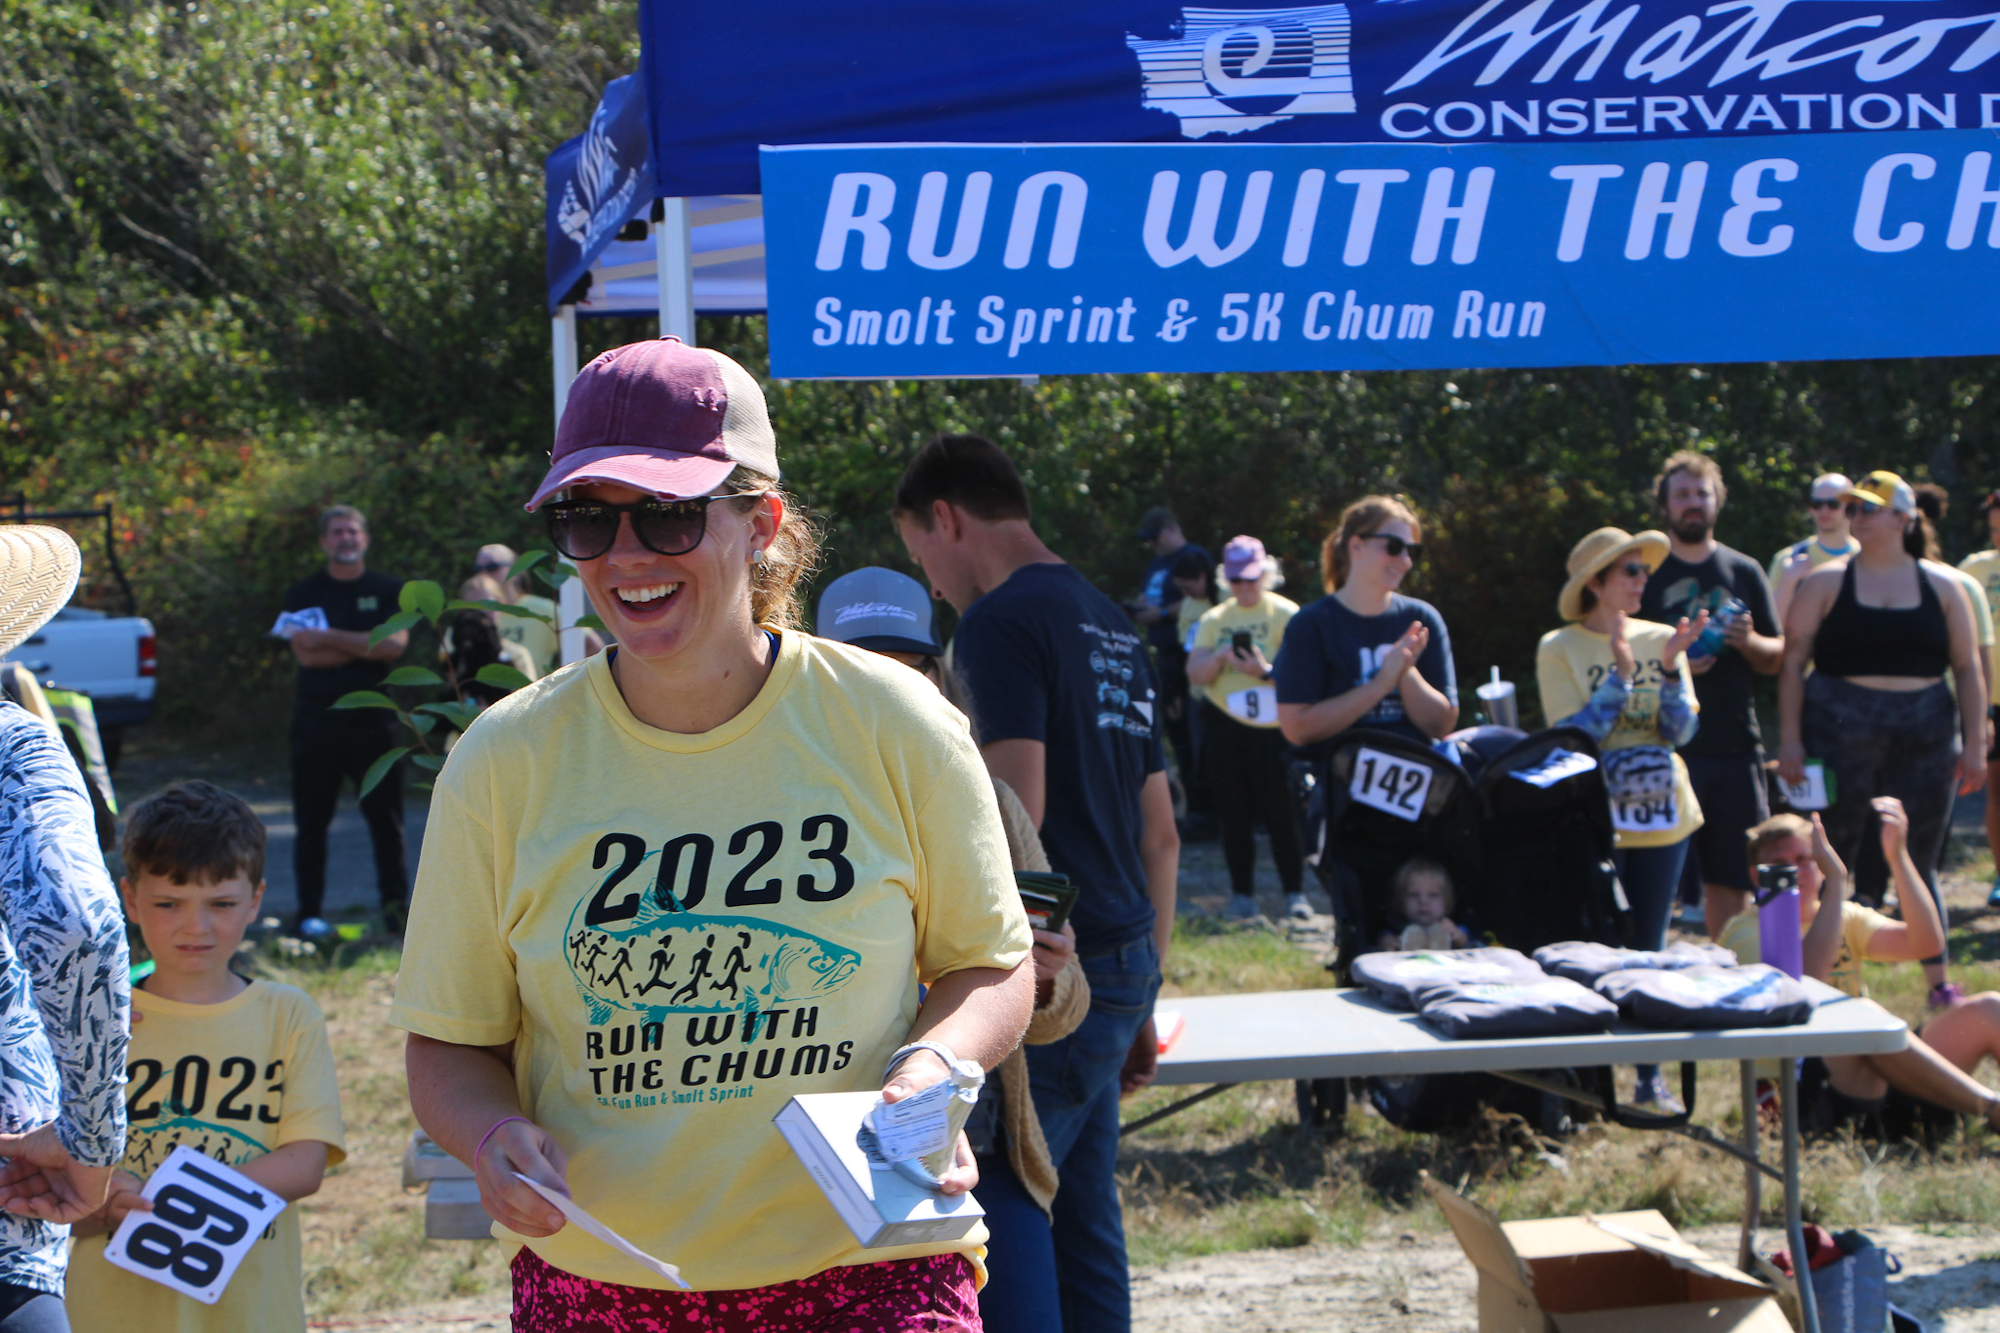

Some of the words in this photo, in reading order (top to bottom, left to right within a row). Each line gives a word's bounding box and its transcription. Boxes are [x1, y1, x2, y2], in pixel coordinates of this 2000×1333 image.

[1380, 93, 1956, 139] CONSERVATION
[815, 171, 1089, 271] RUN
[1142, 166, 1496, 269] WITH
[1550, 158, 1800, 262] THE
[812, 297, 955, 346] Smolt
[975, 295, 1137, 358] Sprint
[1156, 298, 1198, 343] &
[1216, 292, 1284, 342] 5K
[1303, 291, 1435, 341] Chum
[1453, 289, 1546, 339] Run
[1363, 756, 1425, 812] 142
[585, 814, 855, 927] 2023
[586, 1021, 664, 1060] RUN
[685, 1006, 819, 1047] WITH
[588, 1059, 664, 1095] THE
[680, 1040, 854, 1087] CHUMS
[635, 1093, 656, 1108] Run
[672, 1089, 704, 1104] Smolt
[709, 1084, 754, 1104] Sprint
[125, 1161, 269, 1289] 168
